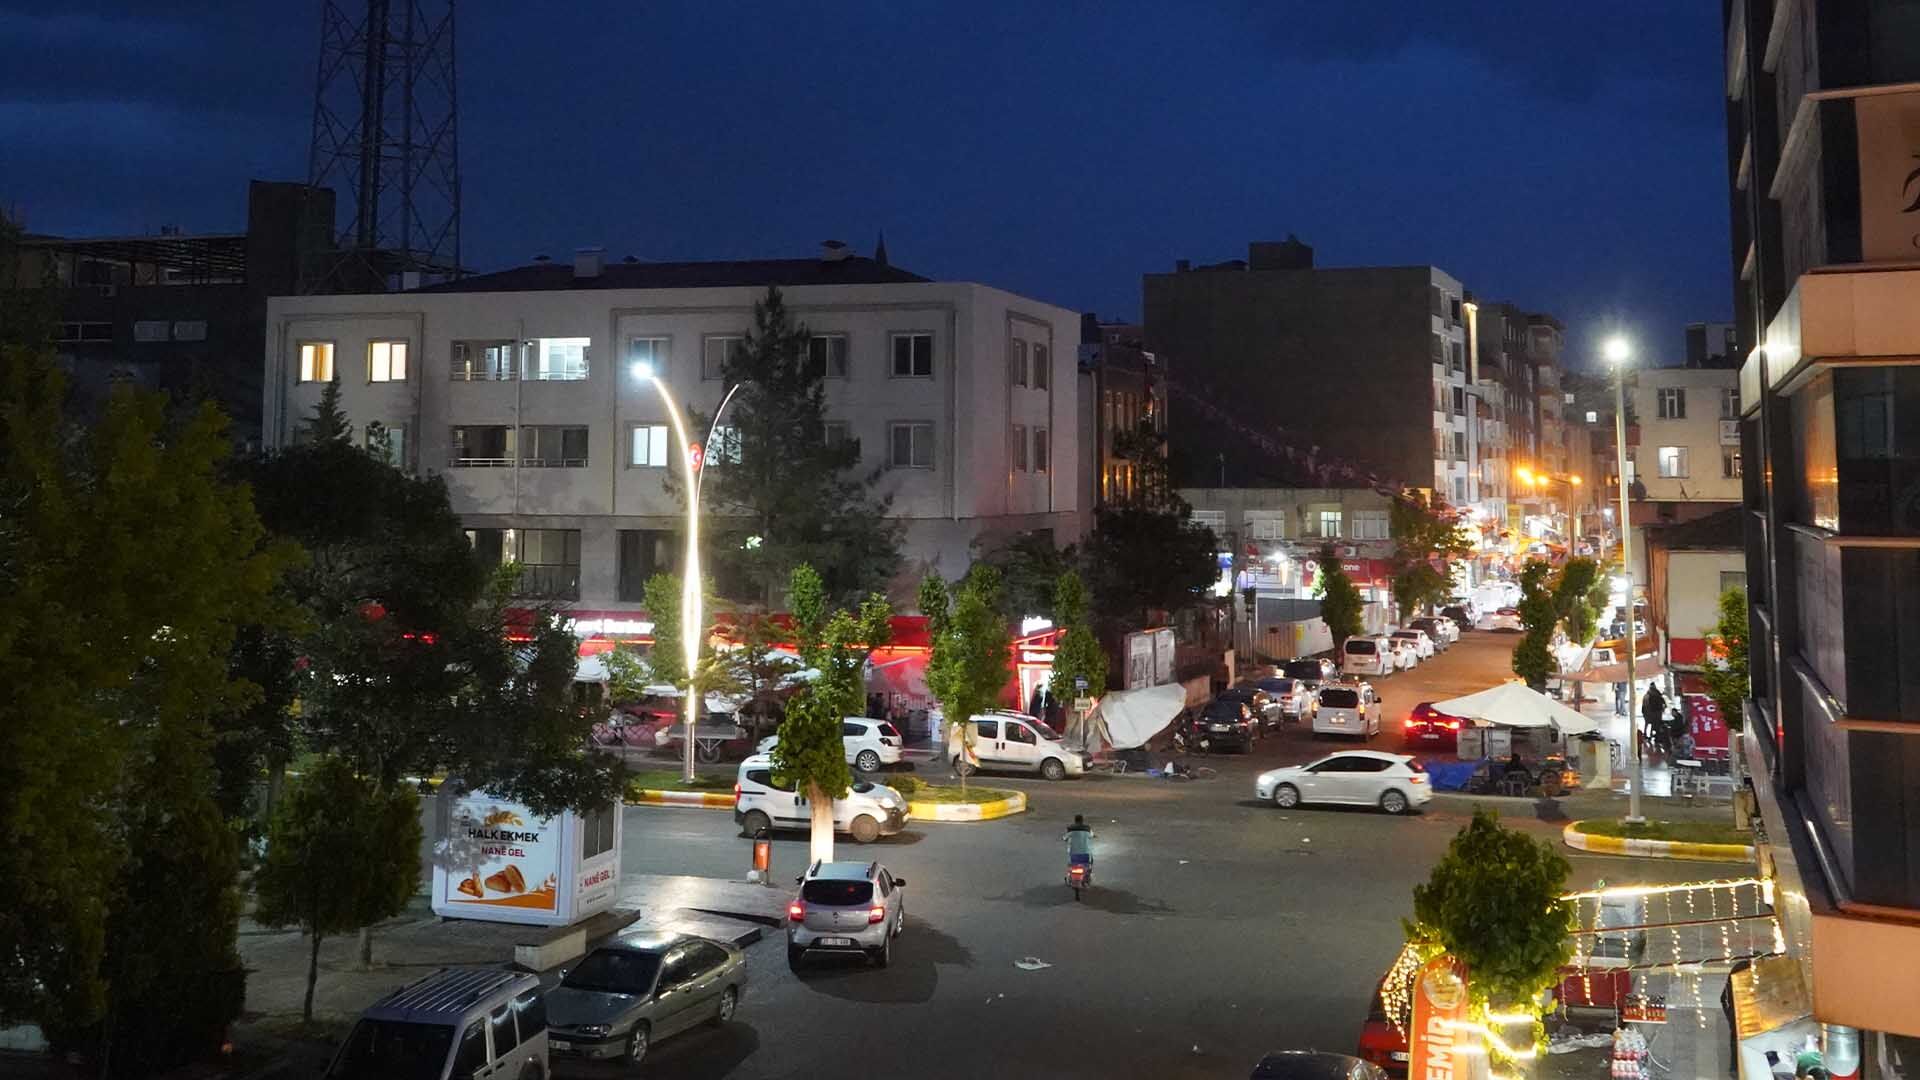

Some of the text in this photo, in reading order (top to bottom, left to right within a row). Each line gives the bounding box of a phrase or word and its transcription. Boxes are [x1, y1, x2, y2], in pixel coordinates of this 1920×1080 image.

[468, 827, 539, 842] HALK EKMEK
[508, 848, 525, 857] GEL
